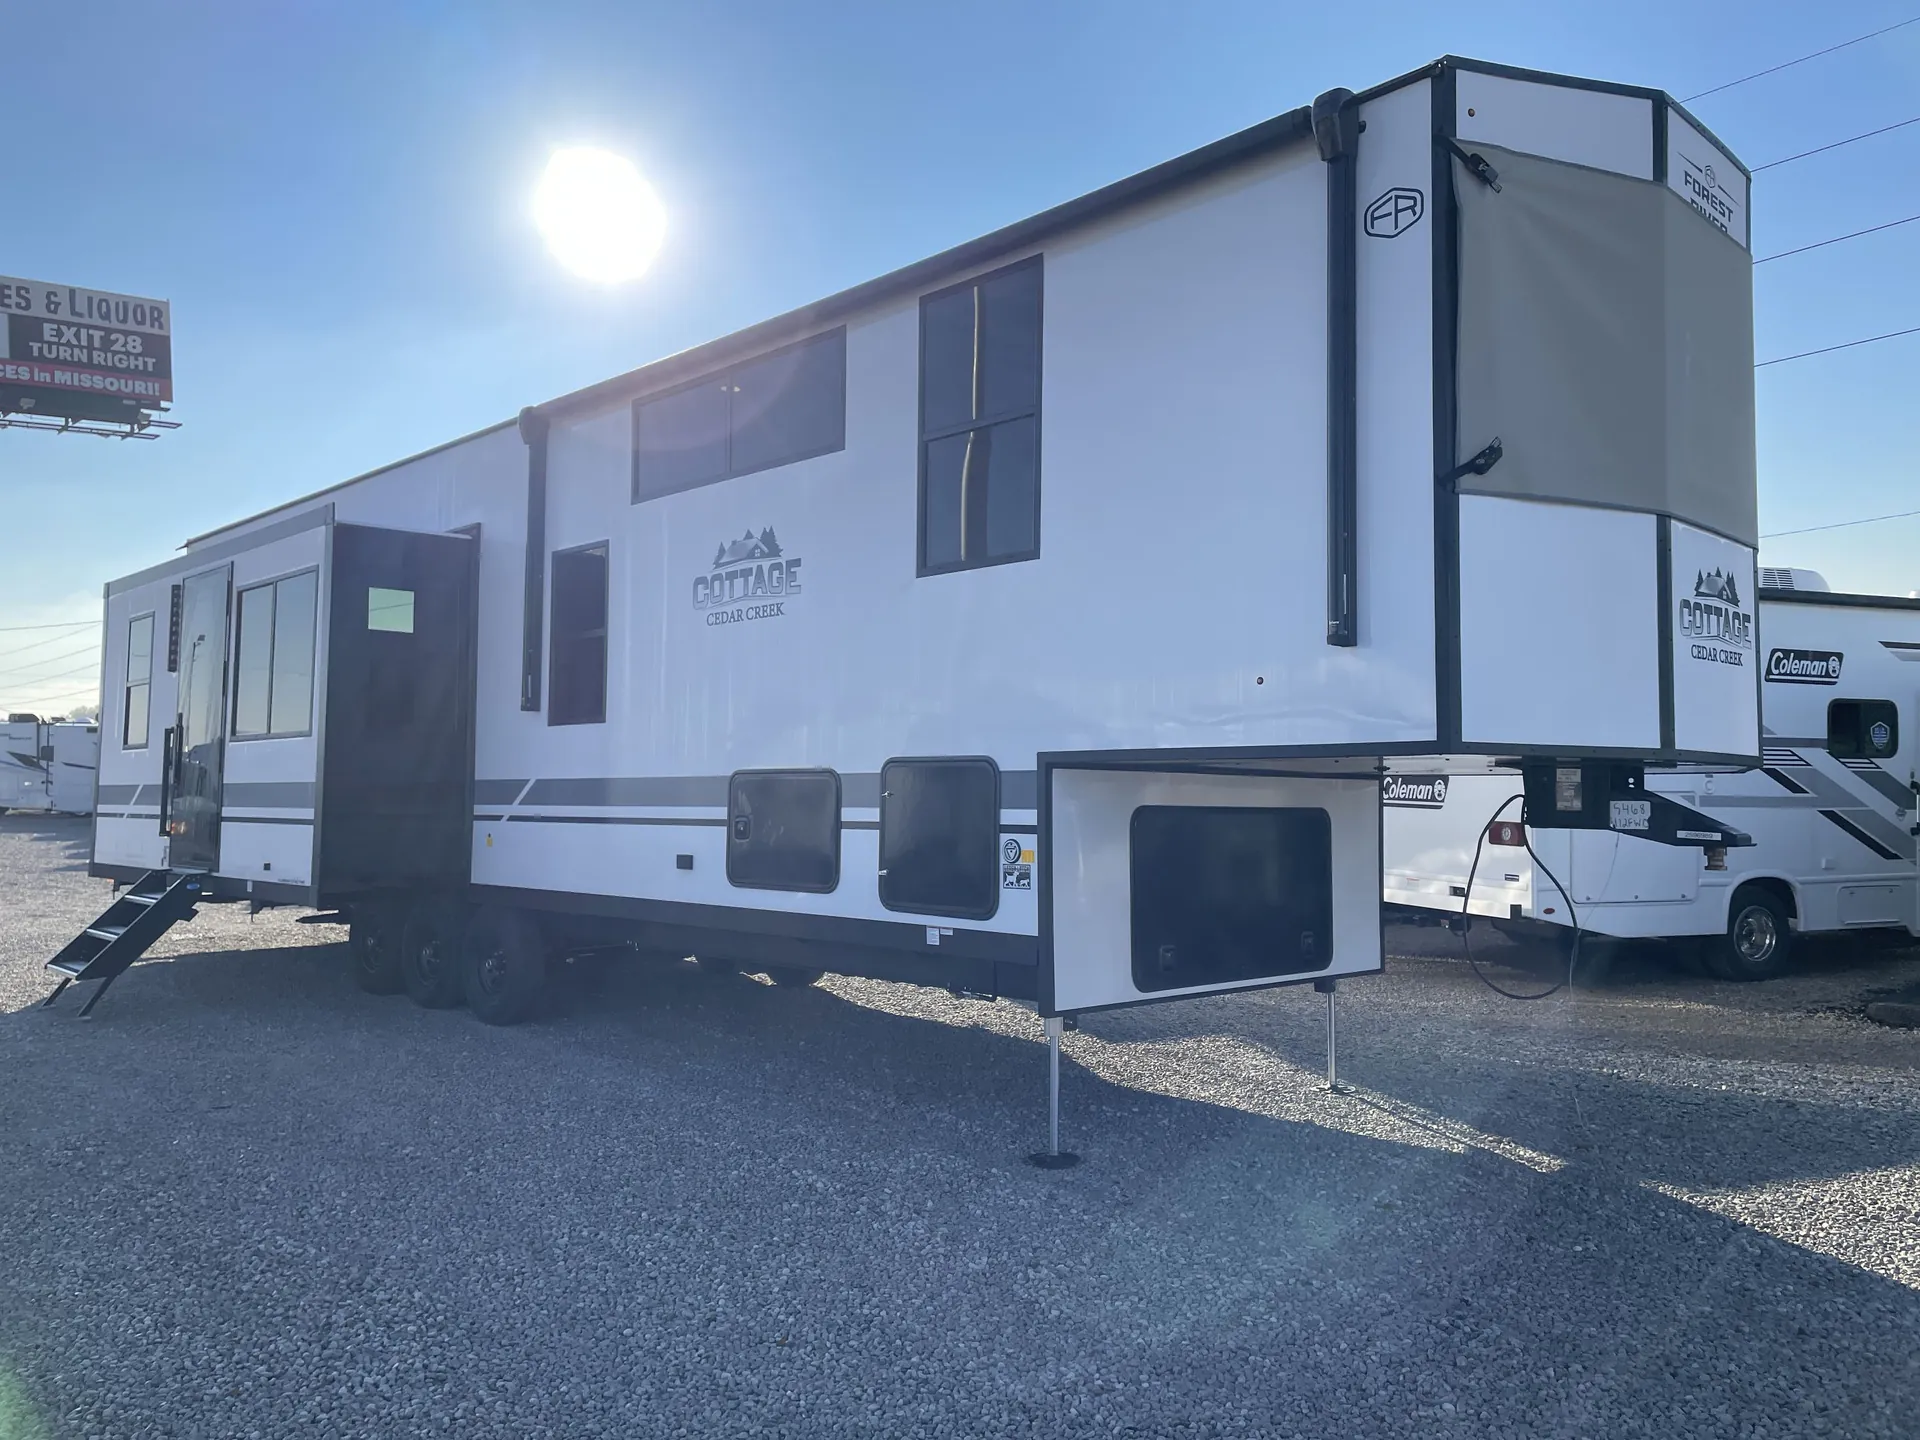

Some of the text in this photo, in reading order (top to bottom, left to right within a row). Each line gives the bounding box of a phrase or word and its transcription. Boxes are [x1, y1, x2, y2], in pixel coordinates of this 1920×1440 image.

[1684, 170, 1733, 222] FOREST
[45, 290, 61, 315] &
[43, 322, 143, 353] EXIT 28
[29, 342, 156, 371] TURN RIGHT
[34, 365, 51, 382] in
[54, 370, 160, 396] MISSOURI!
[693, 558, 802, 610] COTTAGE
[706, 602, 785, 626] CEDAR CREEK
[1680, 598, 1752, 649] COTTAGE
[1691, 644, 1743, 666] CEDAR CREEK
[1771, 651, 1827, 676] Coleman
[1383, 777, 1433, 800] Coleman
